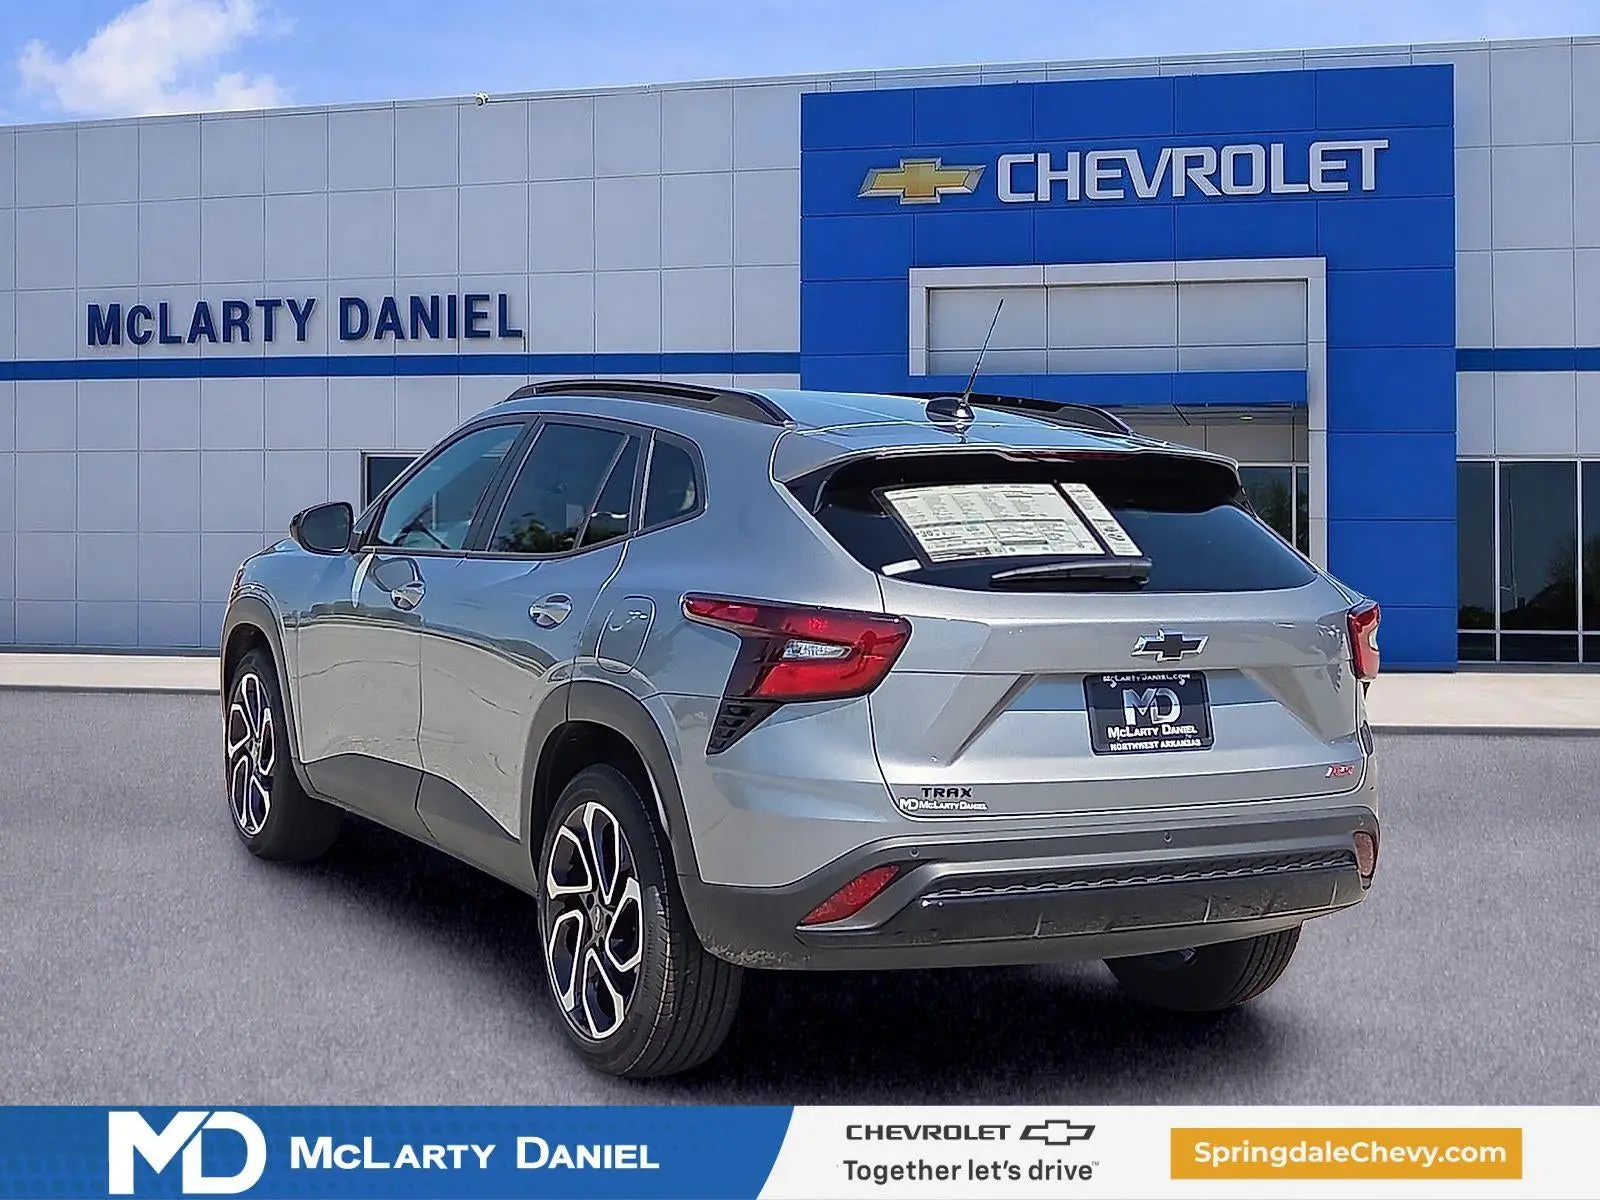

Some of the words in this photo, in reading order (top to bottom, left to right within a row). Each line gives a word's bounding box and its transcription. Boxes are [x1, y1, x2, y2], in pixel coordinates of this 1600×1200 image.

[998, 139, 1388, 205] CHEVROLET
[340, 293, 524, 341] DANIEL
[1123, 688, 1181, 726] MD
[921, 787, 972, 798] TRAX
